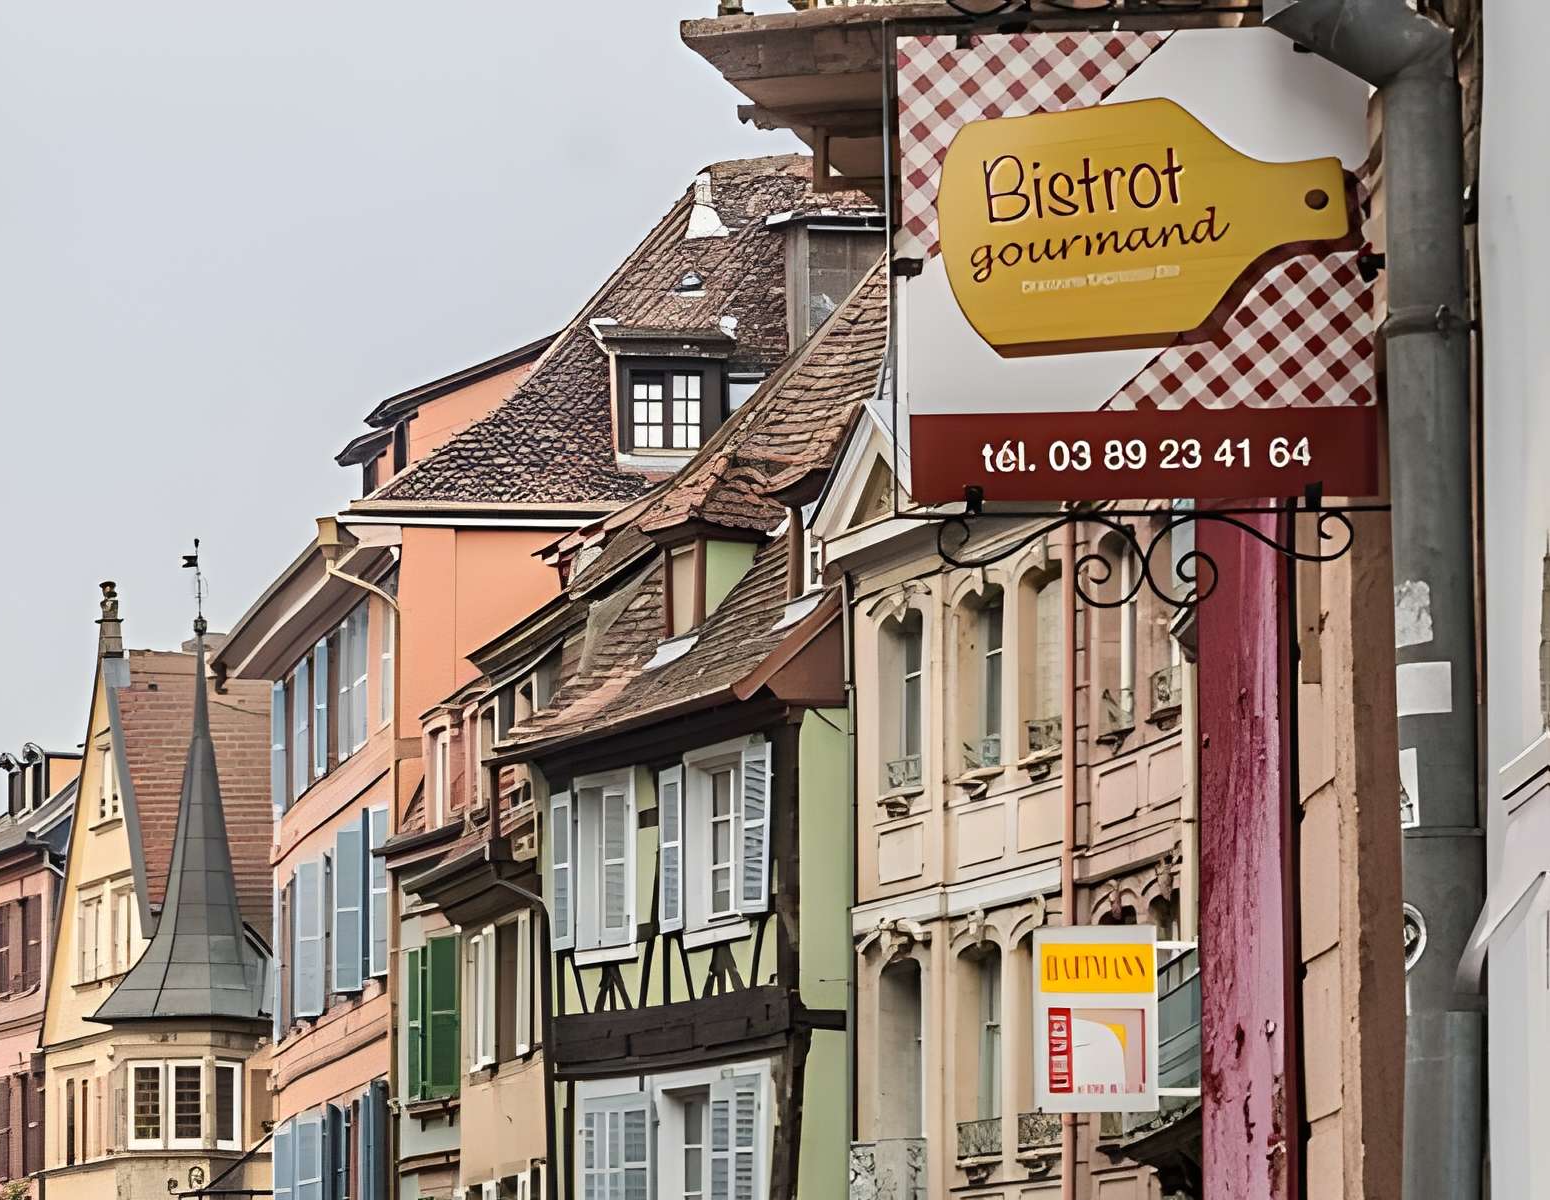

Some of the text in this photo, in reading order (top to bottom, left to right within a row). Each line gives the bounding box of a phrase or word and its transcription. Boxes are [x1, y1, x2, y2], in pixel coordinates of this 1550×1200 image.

[982, 147, 1184, 224] Bistrot
[969, 205, 1231, 283] gourmand
[982, 436, 1312, 473] tél. 03 89 23 41 64
